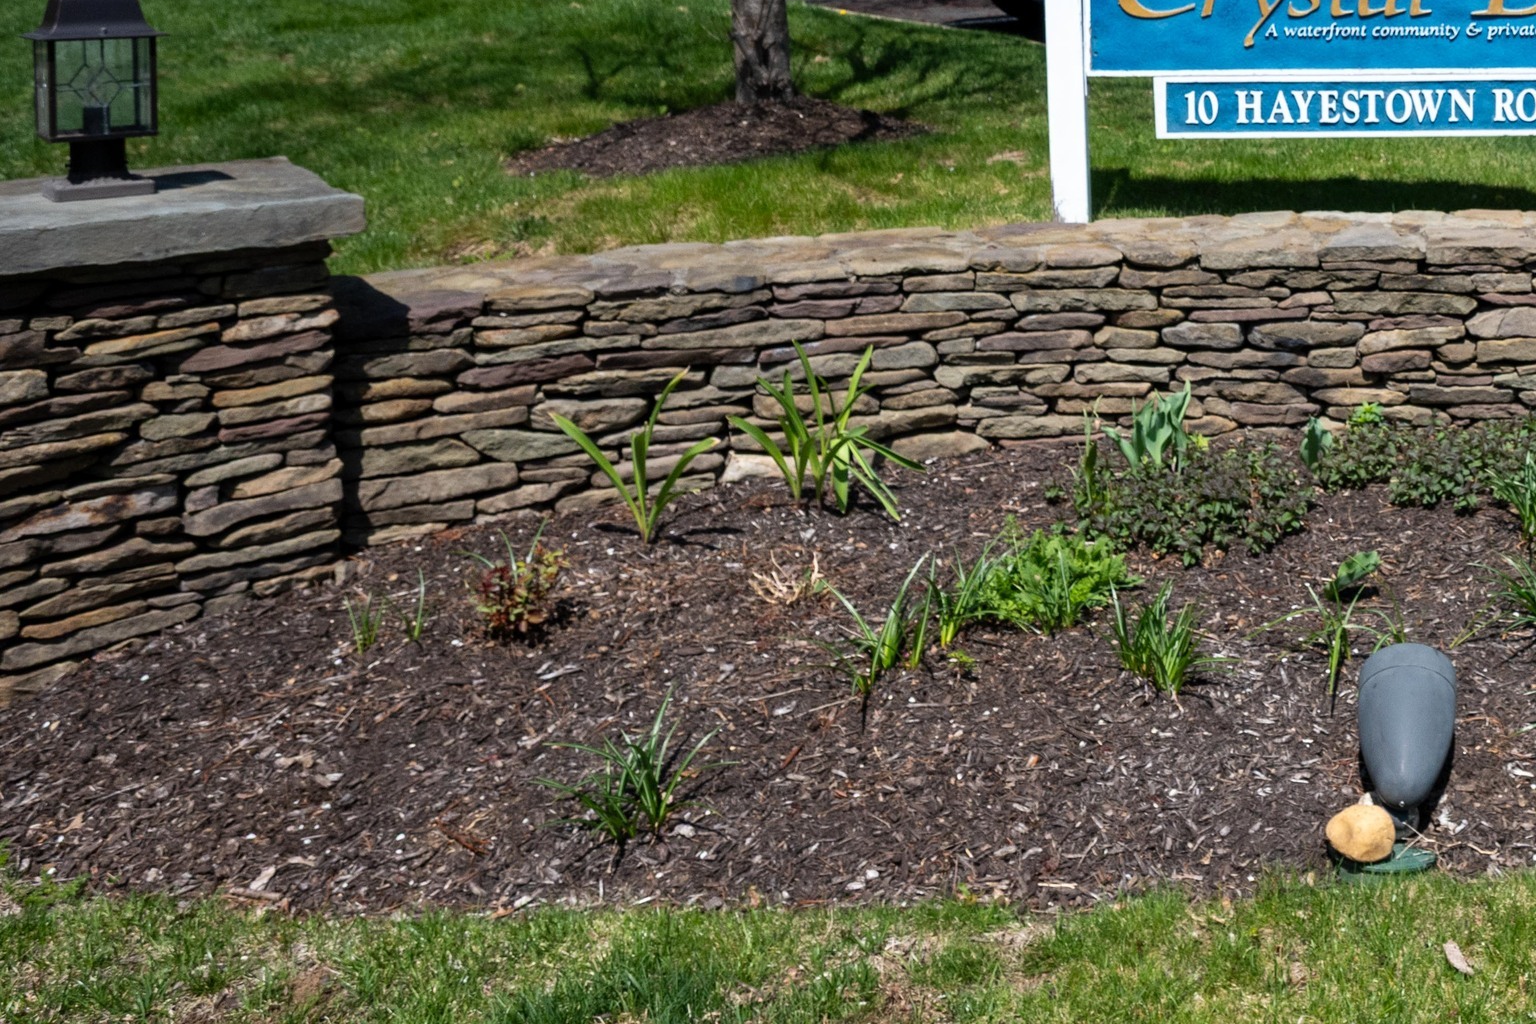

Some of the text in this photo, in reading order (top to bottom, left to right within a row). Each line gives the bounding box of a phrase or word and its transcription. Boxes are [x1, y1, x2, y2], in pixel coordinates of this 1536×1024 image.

[1265, 23, 1278, 37] A
[1284, 22, 1366, 41] waterfront
[1372, 23, 1460, 41] community
[1465, 23, 1482, 36] &
[1184, 90, 1219, 125] 10
[1235, 88, 1476, 124] HAYESTOWN
